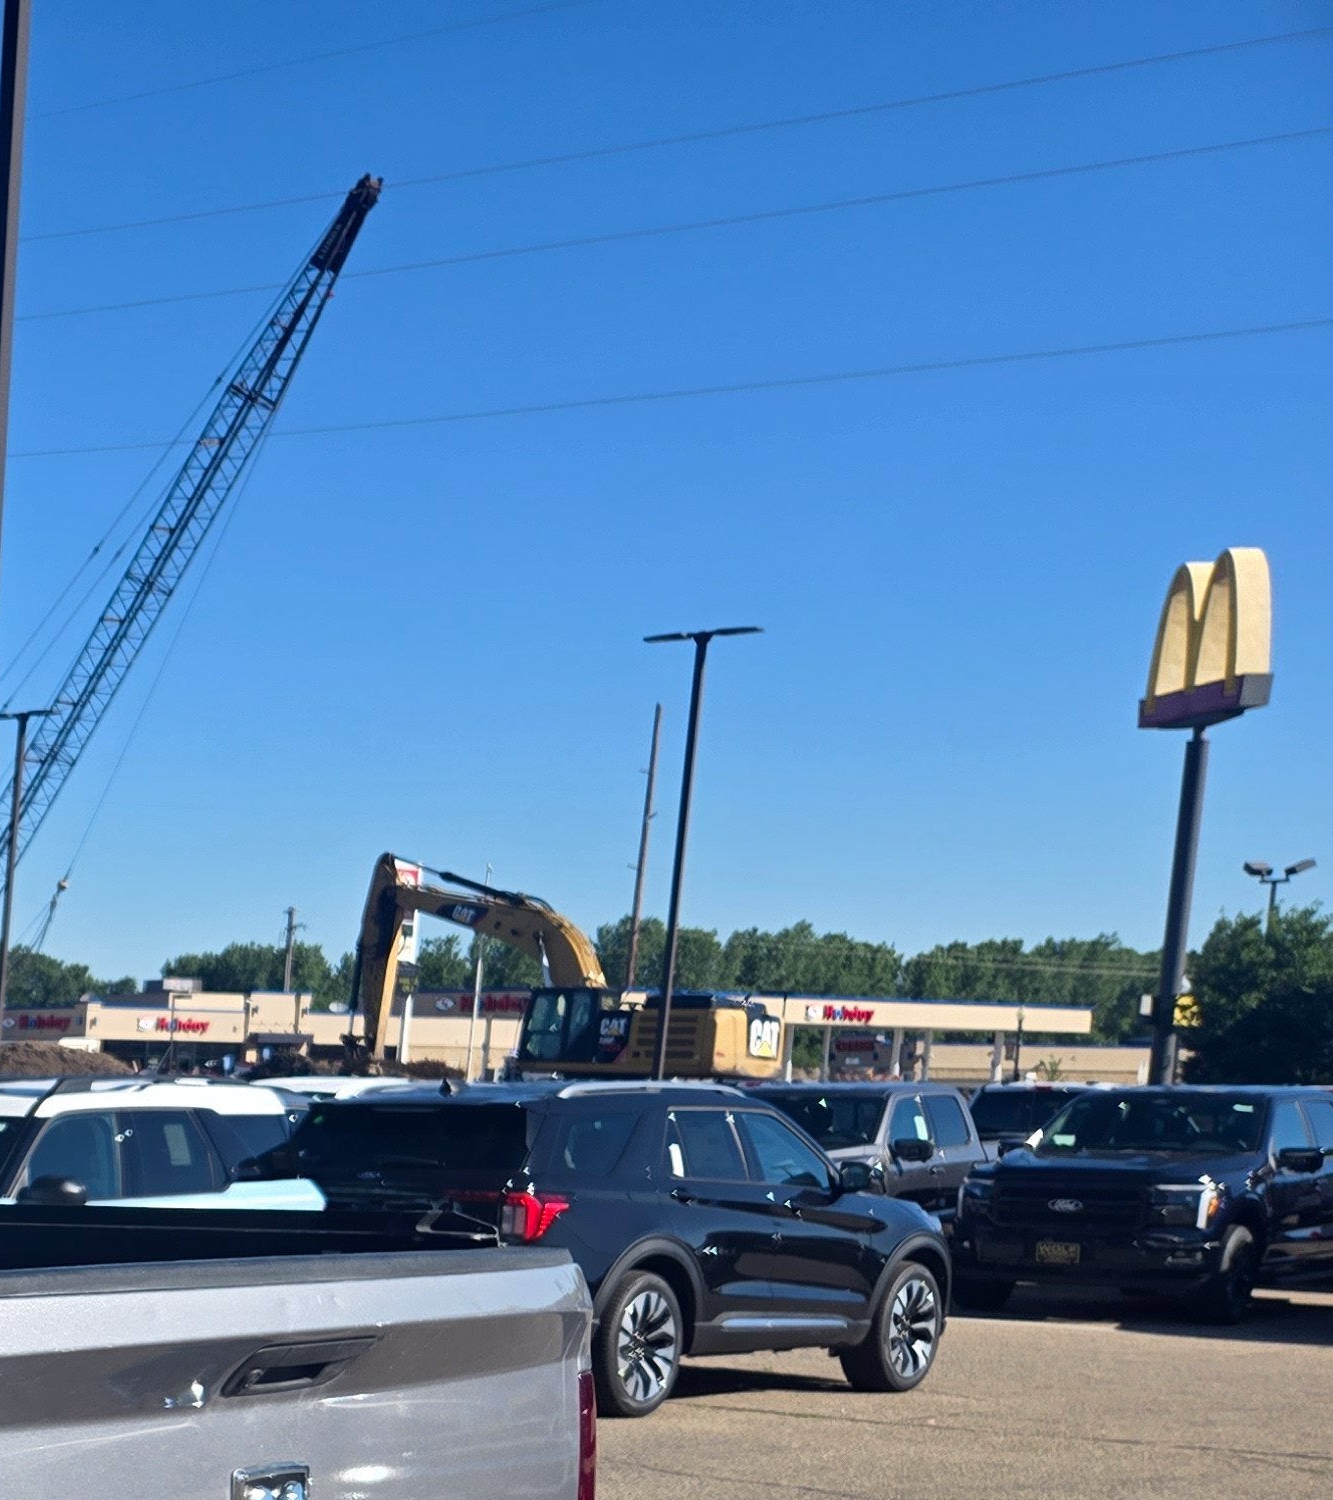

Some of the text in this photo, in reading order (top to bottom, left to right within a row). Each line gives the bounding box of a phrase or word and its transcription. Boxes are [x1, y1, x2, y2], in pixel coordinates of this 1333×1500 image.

[452, 905, 475, 923] CAT
[600, 1018, 627, 1036] CAT
[750, 1019, 780, 1058] CAT
